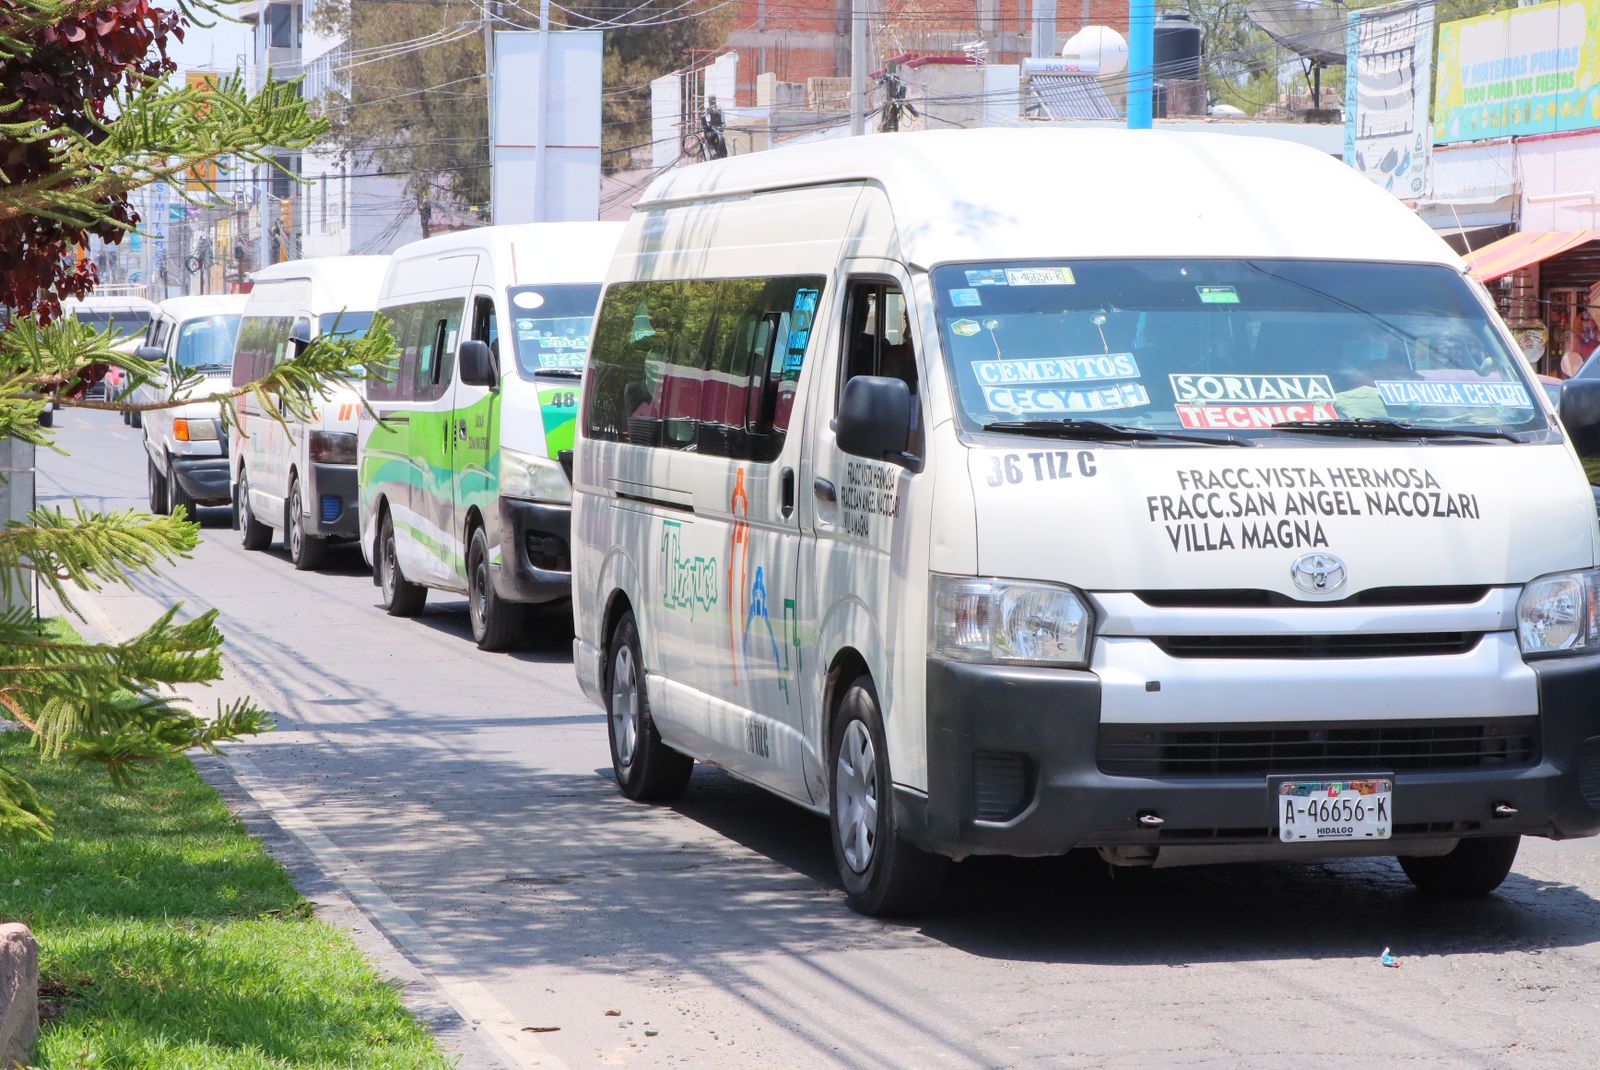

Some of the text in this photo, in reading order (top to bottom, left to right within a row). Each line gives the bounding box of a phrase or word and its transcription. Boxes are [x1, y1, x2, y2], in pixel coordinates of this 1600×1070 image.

[1046, 63, 1080, 72] RAYSOL
[1471, 54, 1527, 84] MATERIAS
[1530, 46, 1579, 74] PRIMAS
[1464, 71, 1575, 105] TODO PARA TUS FIESTAS
[979, 355, 1134, 383] CEMENTOS
[551, 392, 575, 408] 48
[1177, 376, 1331, 400] SORIANA
[1379, 383, 1531, 406] TIZAYUCA CENTRO
[1179, 404, 1330, 428] TECNICA
[986, 450, 1097, 488] 36 TIZ C
[1326, 467, 1441, 490] HERMOSA
[1284, 491, 1361, 518] ANGEL
[1366, 491, 1480, 520] NACOZARI
[1165, 519, 1330, 553] VILLA MAGNA
[661, 520, 718, 623] Tizayuca
[1285, 796, 1388, 825] A-46656-K
[1316, 826, 1354, 835] HIDALGO
